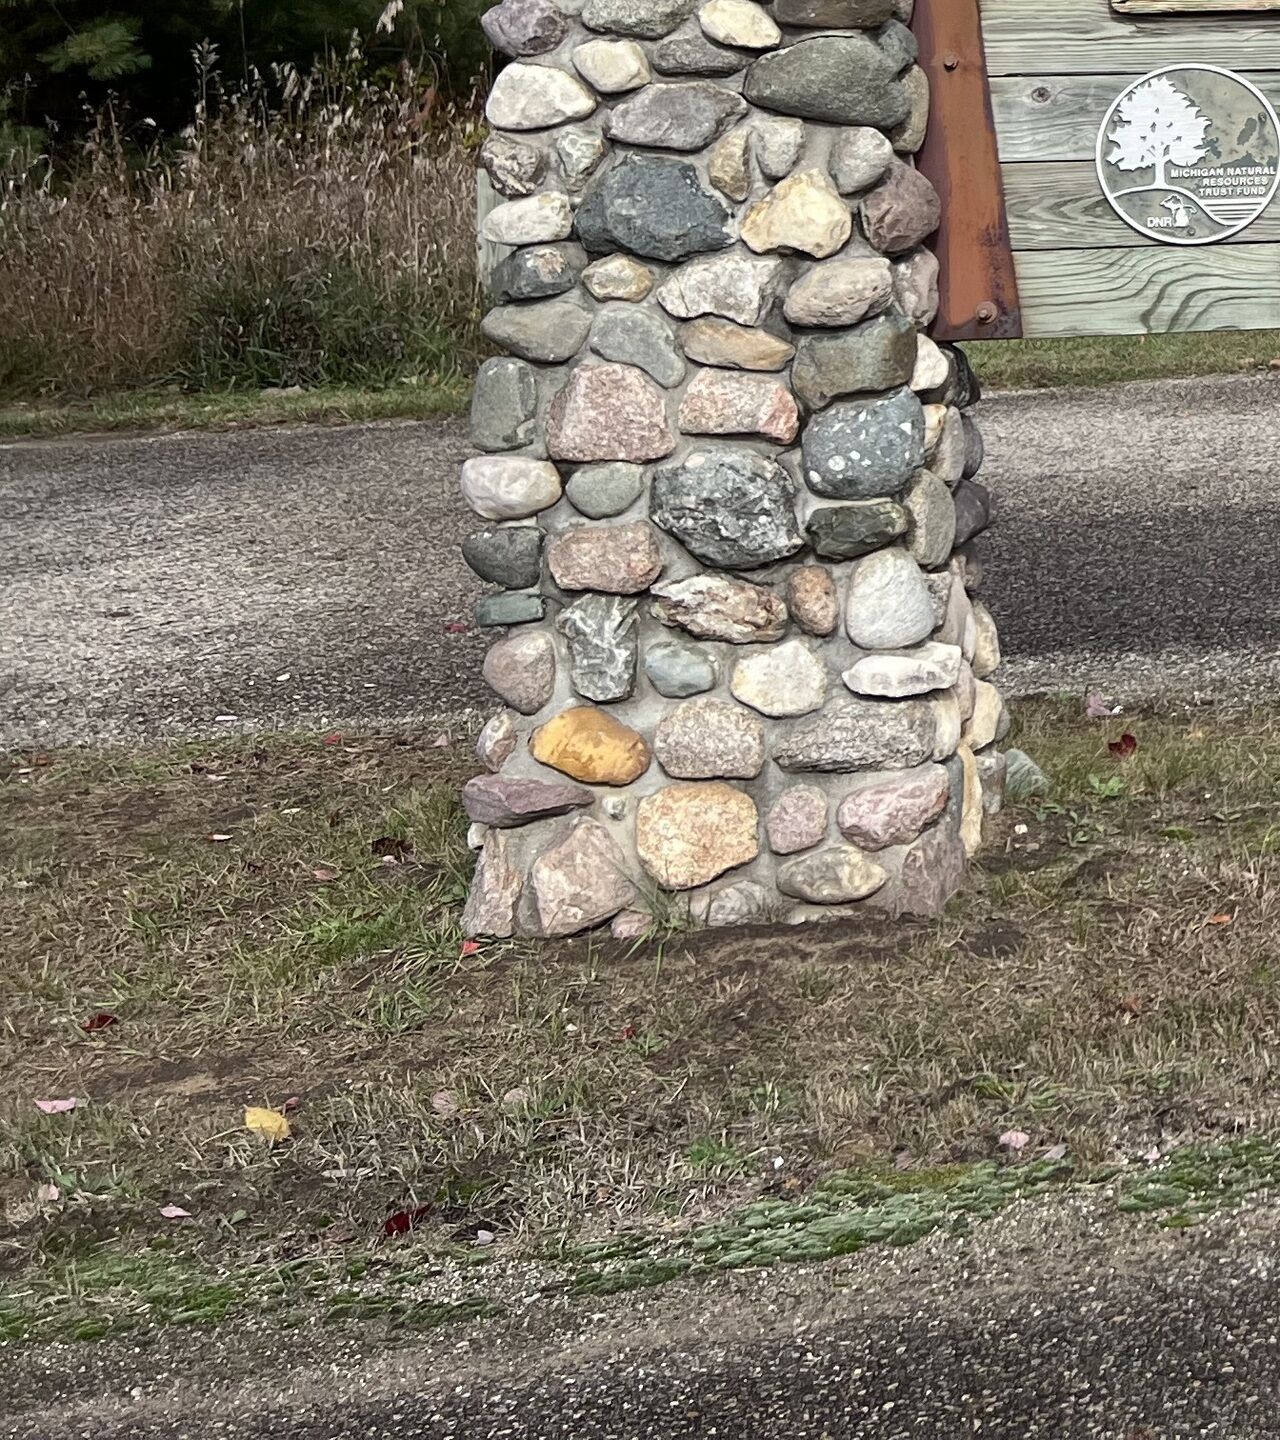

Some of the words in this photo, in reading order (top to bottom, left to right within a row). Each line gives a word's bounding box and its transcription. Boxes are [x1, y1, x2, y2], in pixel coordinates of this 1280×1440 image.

[1170, 168, 1224, 178] MICHIGAN
[1227, 166, 1276, 176] NATURAL
[1202, 177, 1268, 187] RESOURCES
[1199, 188, 1234, 196] TRUST
[1236, 187, 1266, 196] FUND
[1146, 216, 1172, 228] DNR
